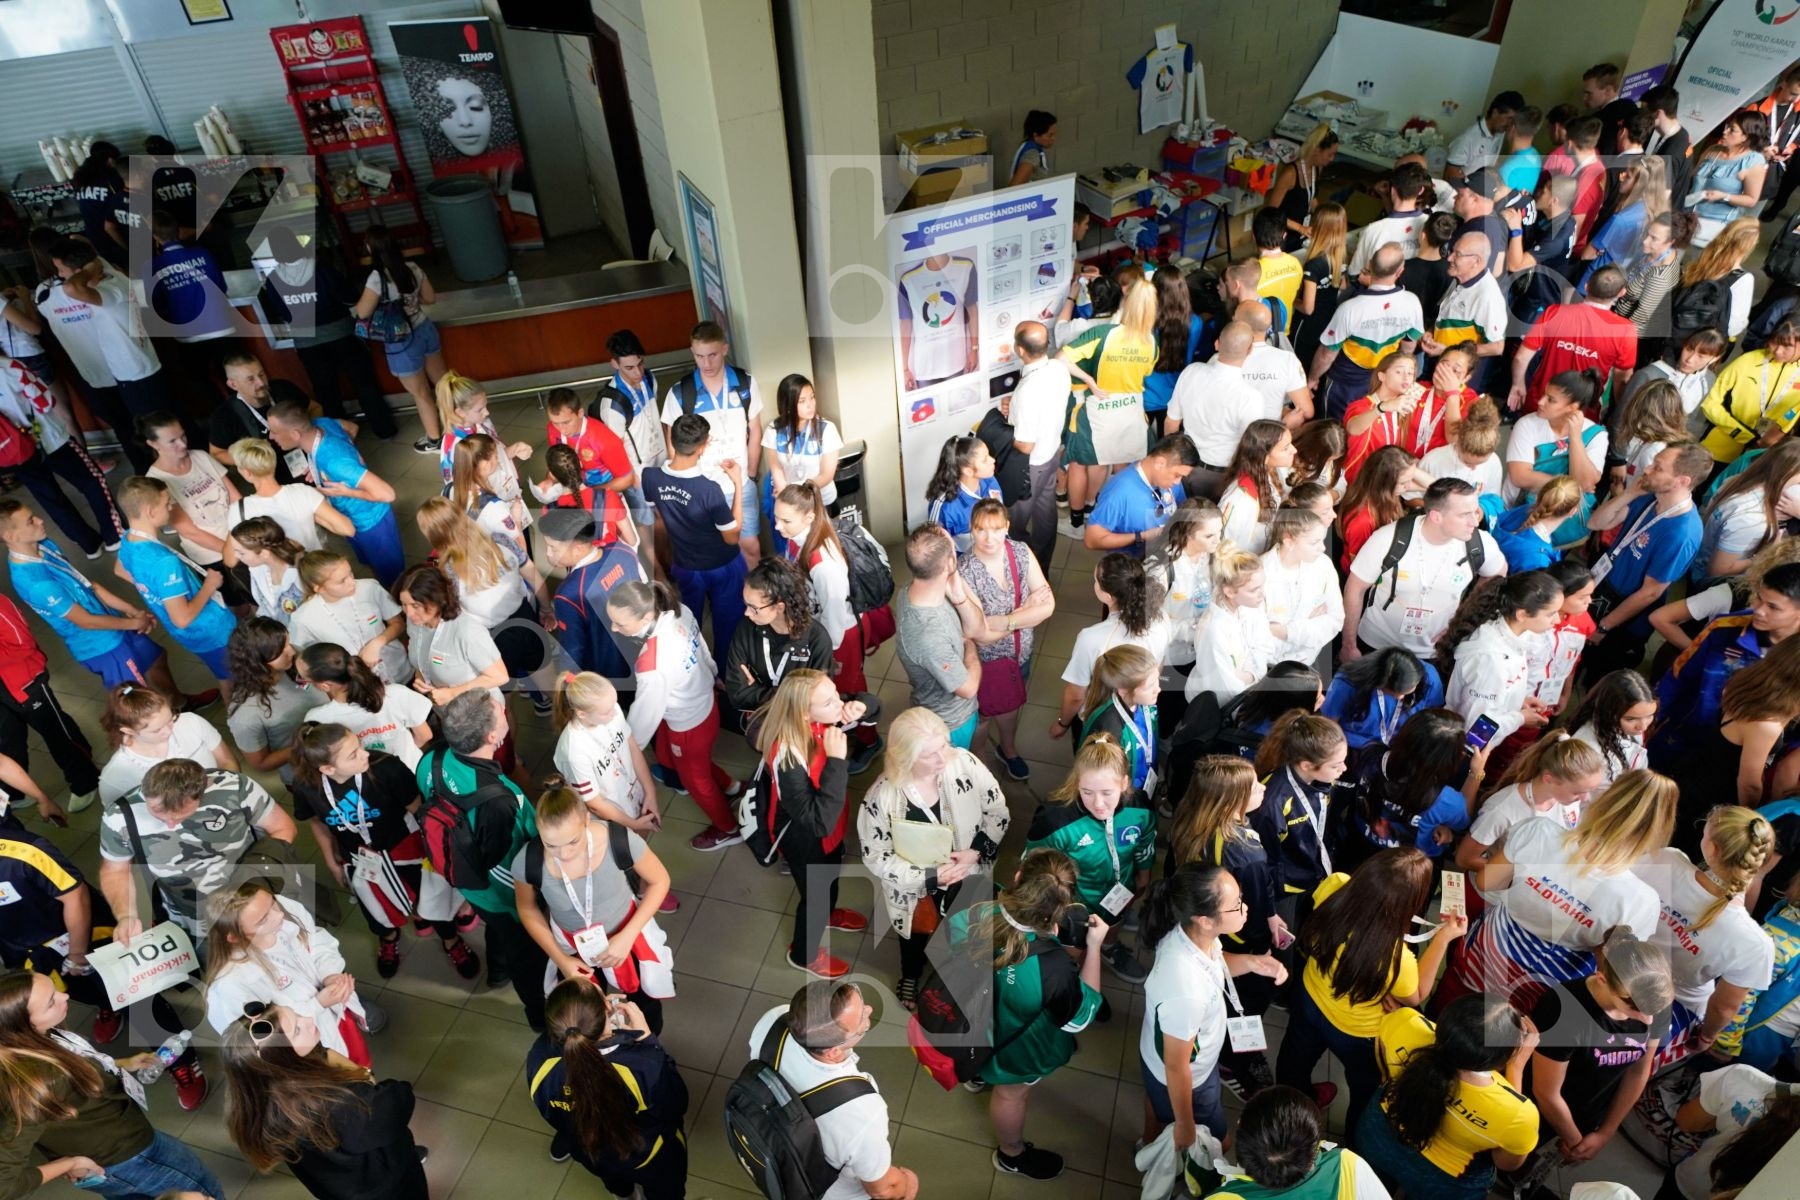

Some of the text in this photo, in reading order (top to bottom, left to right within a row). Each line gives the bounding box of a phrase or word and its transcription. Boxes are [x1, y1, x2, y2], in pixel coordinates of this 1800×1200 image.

[1688, 75, 1741, 95] MERCHANDISING
[77, 186, 108, 201] TAFF
[156, 182, 193, 201] STAFF
[114, 209, 142, 228] STAFF
[923, 201, 1038, 235] OFFICIAL MERCHANDISING
[156, 256, 207, 279] ESTONIAN
[283, 292, 318, 305] EGYPT
[54, 303, 90, 314] HRVATSK
[1242, 373, 1279, 381] TUGAL
[1097, 396, 1137, 410] AFRICA
[658, 485, 692, 500] KARATE
[356, 724, 397, 739] GARIAN
[1525, 876, 1595, 929] SLOVAKIA
[1541, 876, 1593, 914] KARATE
[1660, 911, 1700, 956] OVAKIA
[118, 934, 178, 967] POL
[1599, 1050, 1643, 1066] PUMA
